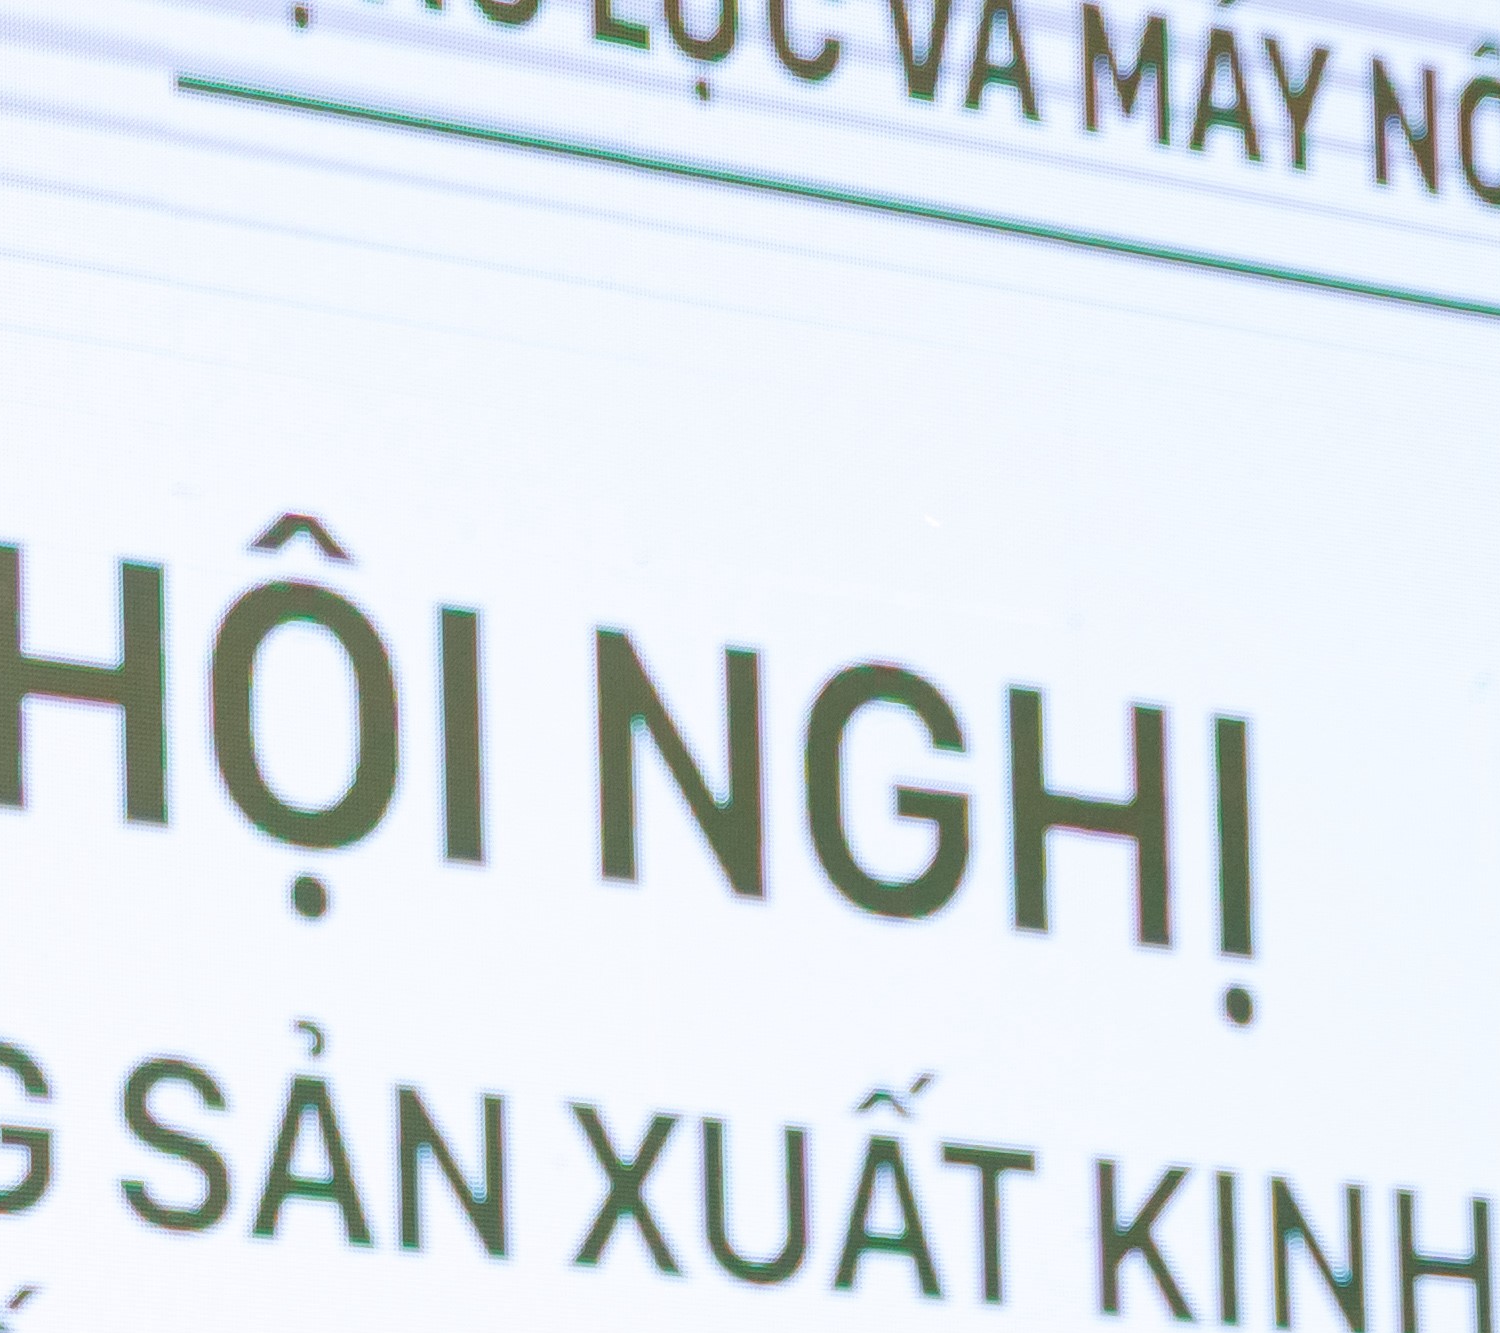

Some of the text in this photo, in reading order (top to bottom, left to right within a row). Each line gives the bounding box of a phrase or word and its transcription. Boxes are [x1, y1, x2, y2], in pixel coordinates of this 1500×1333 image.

[1081, 0, 1330, 170] MÁY
[595, 626, 1256, 1027] NGHỊ
[121, 1022, 508, 1258] SẢN
[572, 1076, 1036, 1304] XUẤT
